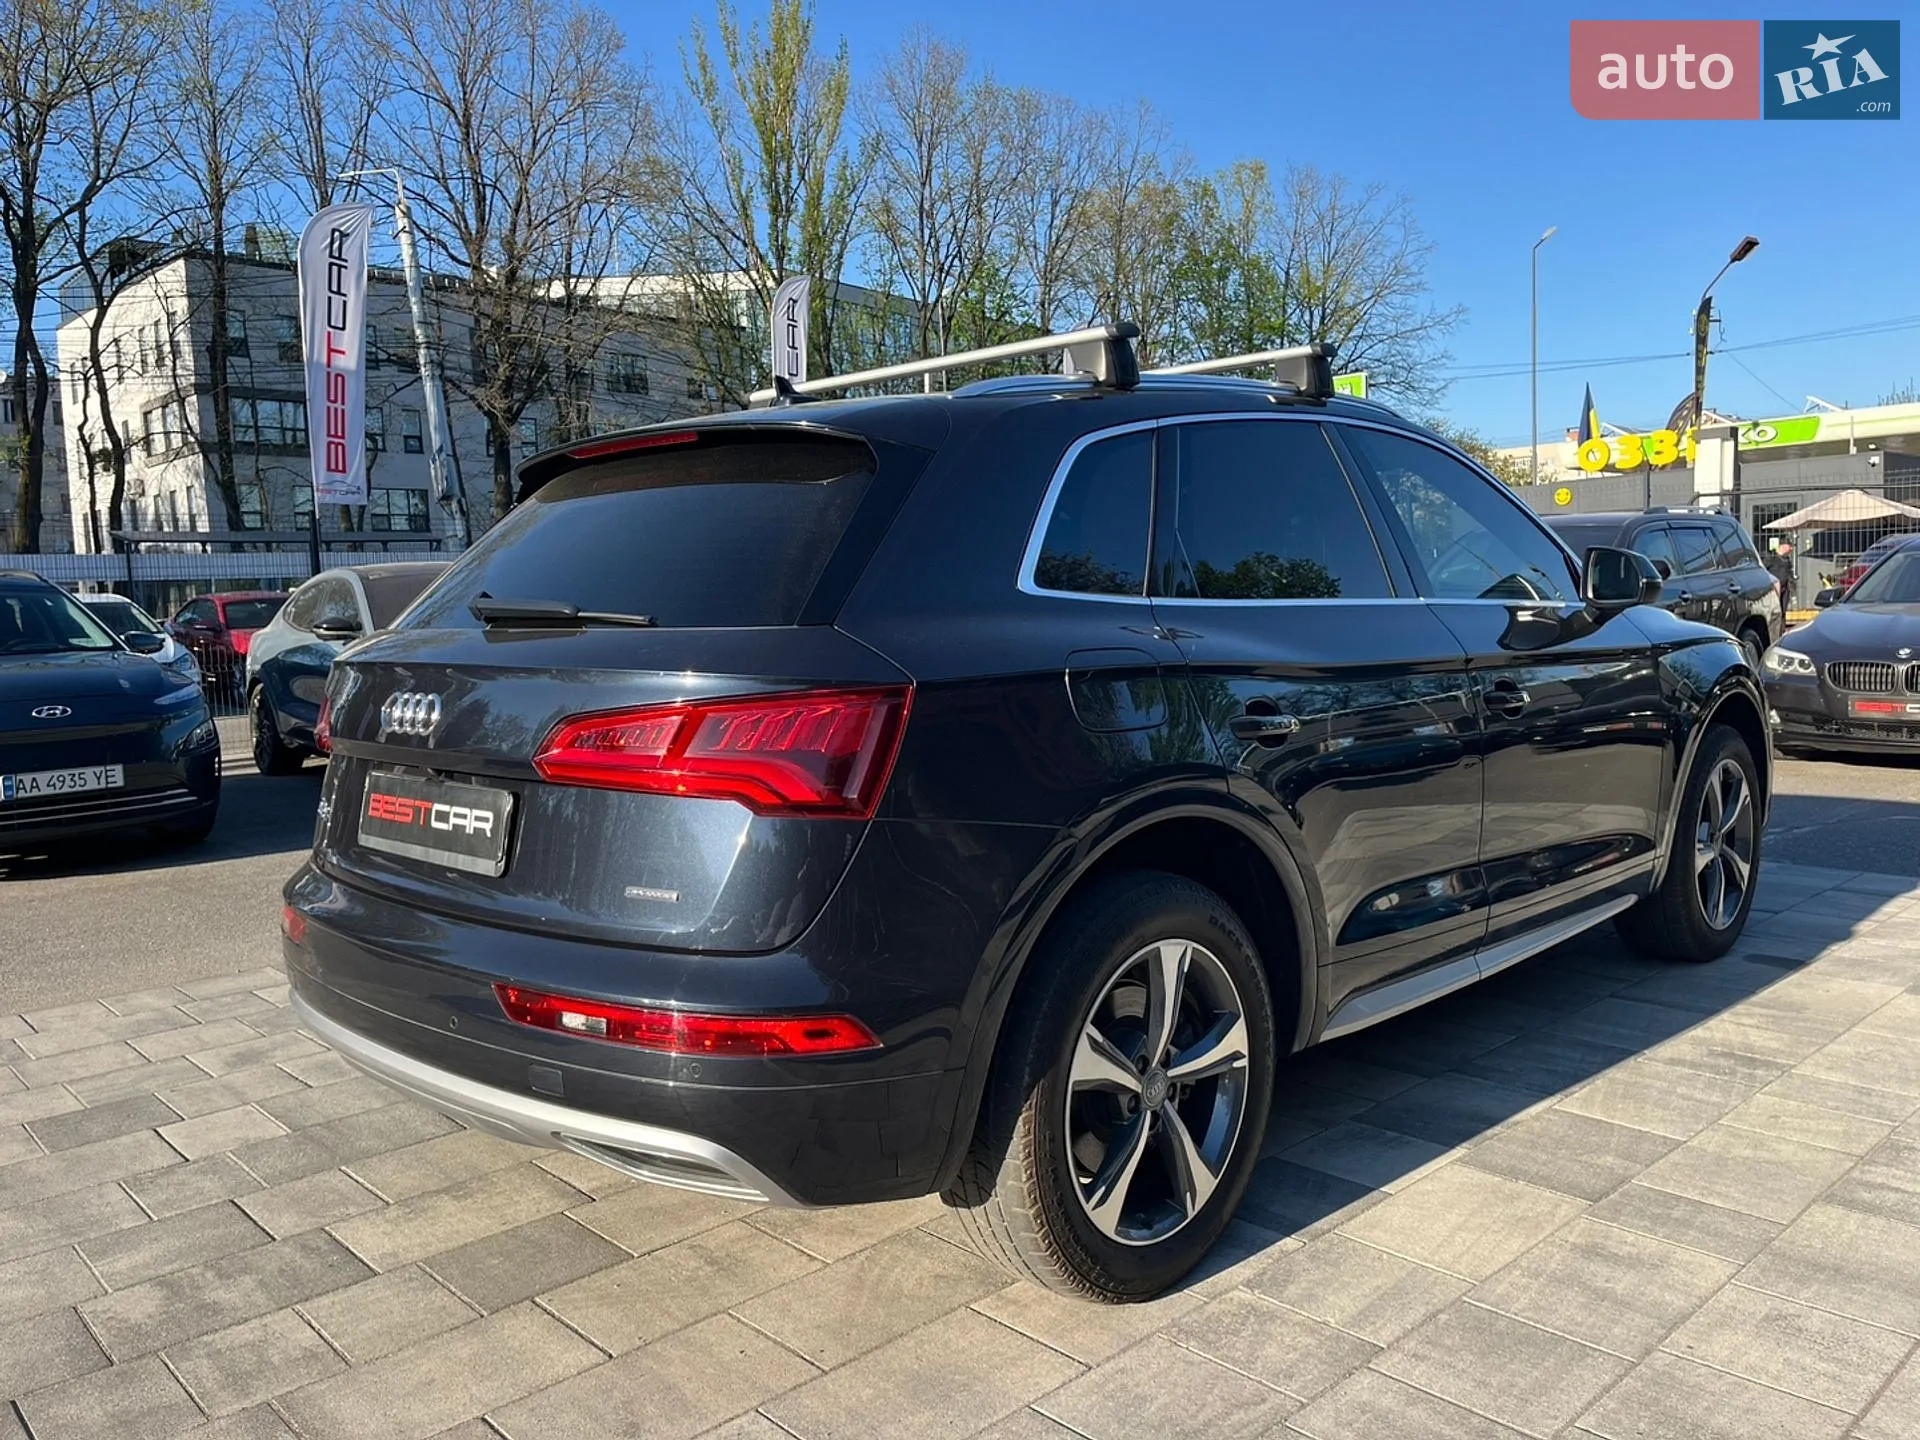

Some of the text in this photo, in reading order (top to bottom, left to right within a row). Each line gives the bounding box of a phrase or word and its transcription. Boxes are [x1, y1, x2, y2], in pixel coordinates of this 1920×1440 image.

[325, 226, 350, 475] BESTCAR
[16, 777, 41, 794] AA
[46, 771, 88, 791] 4935
[368, 793, 494, 837] BESTCAR
